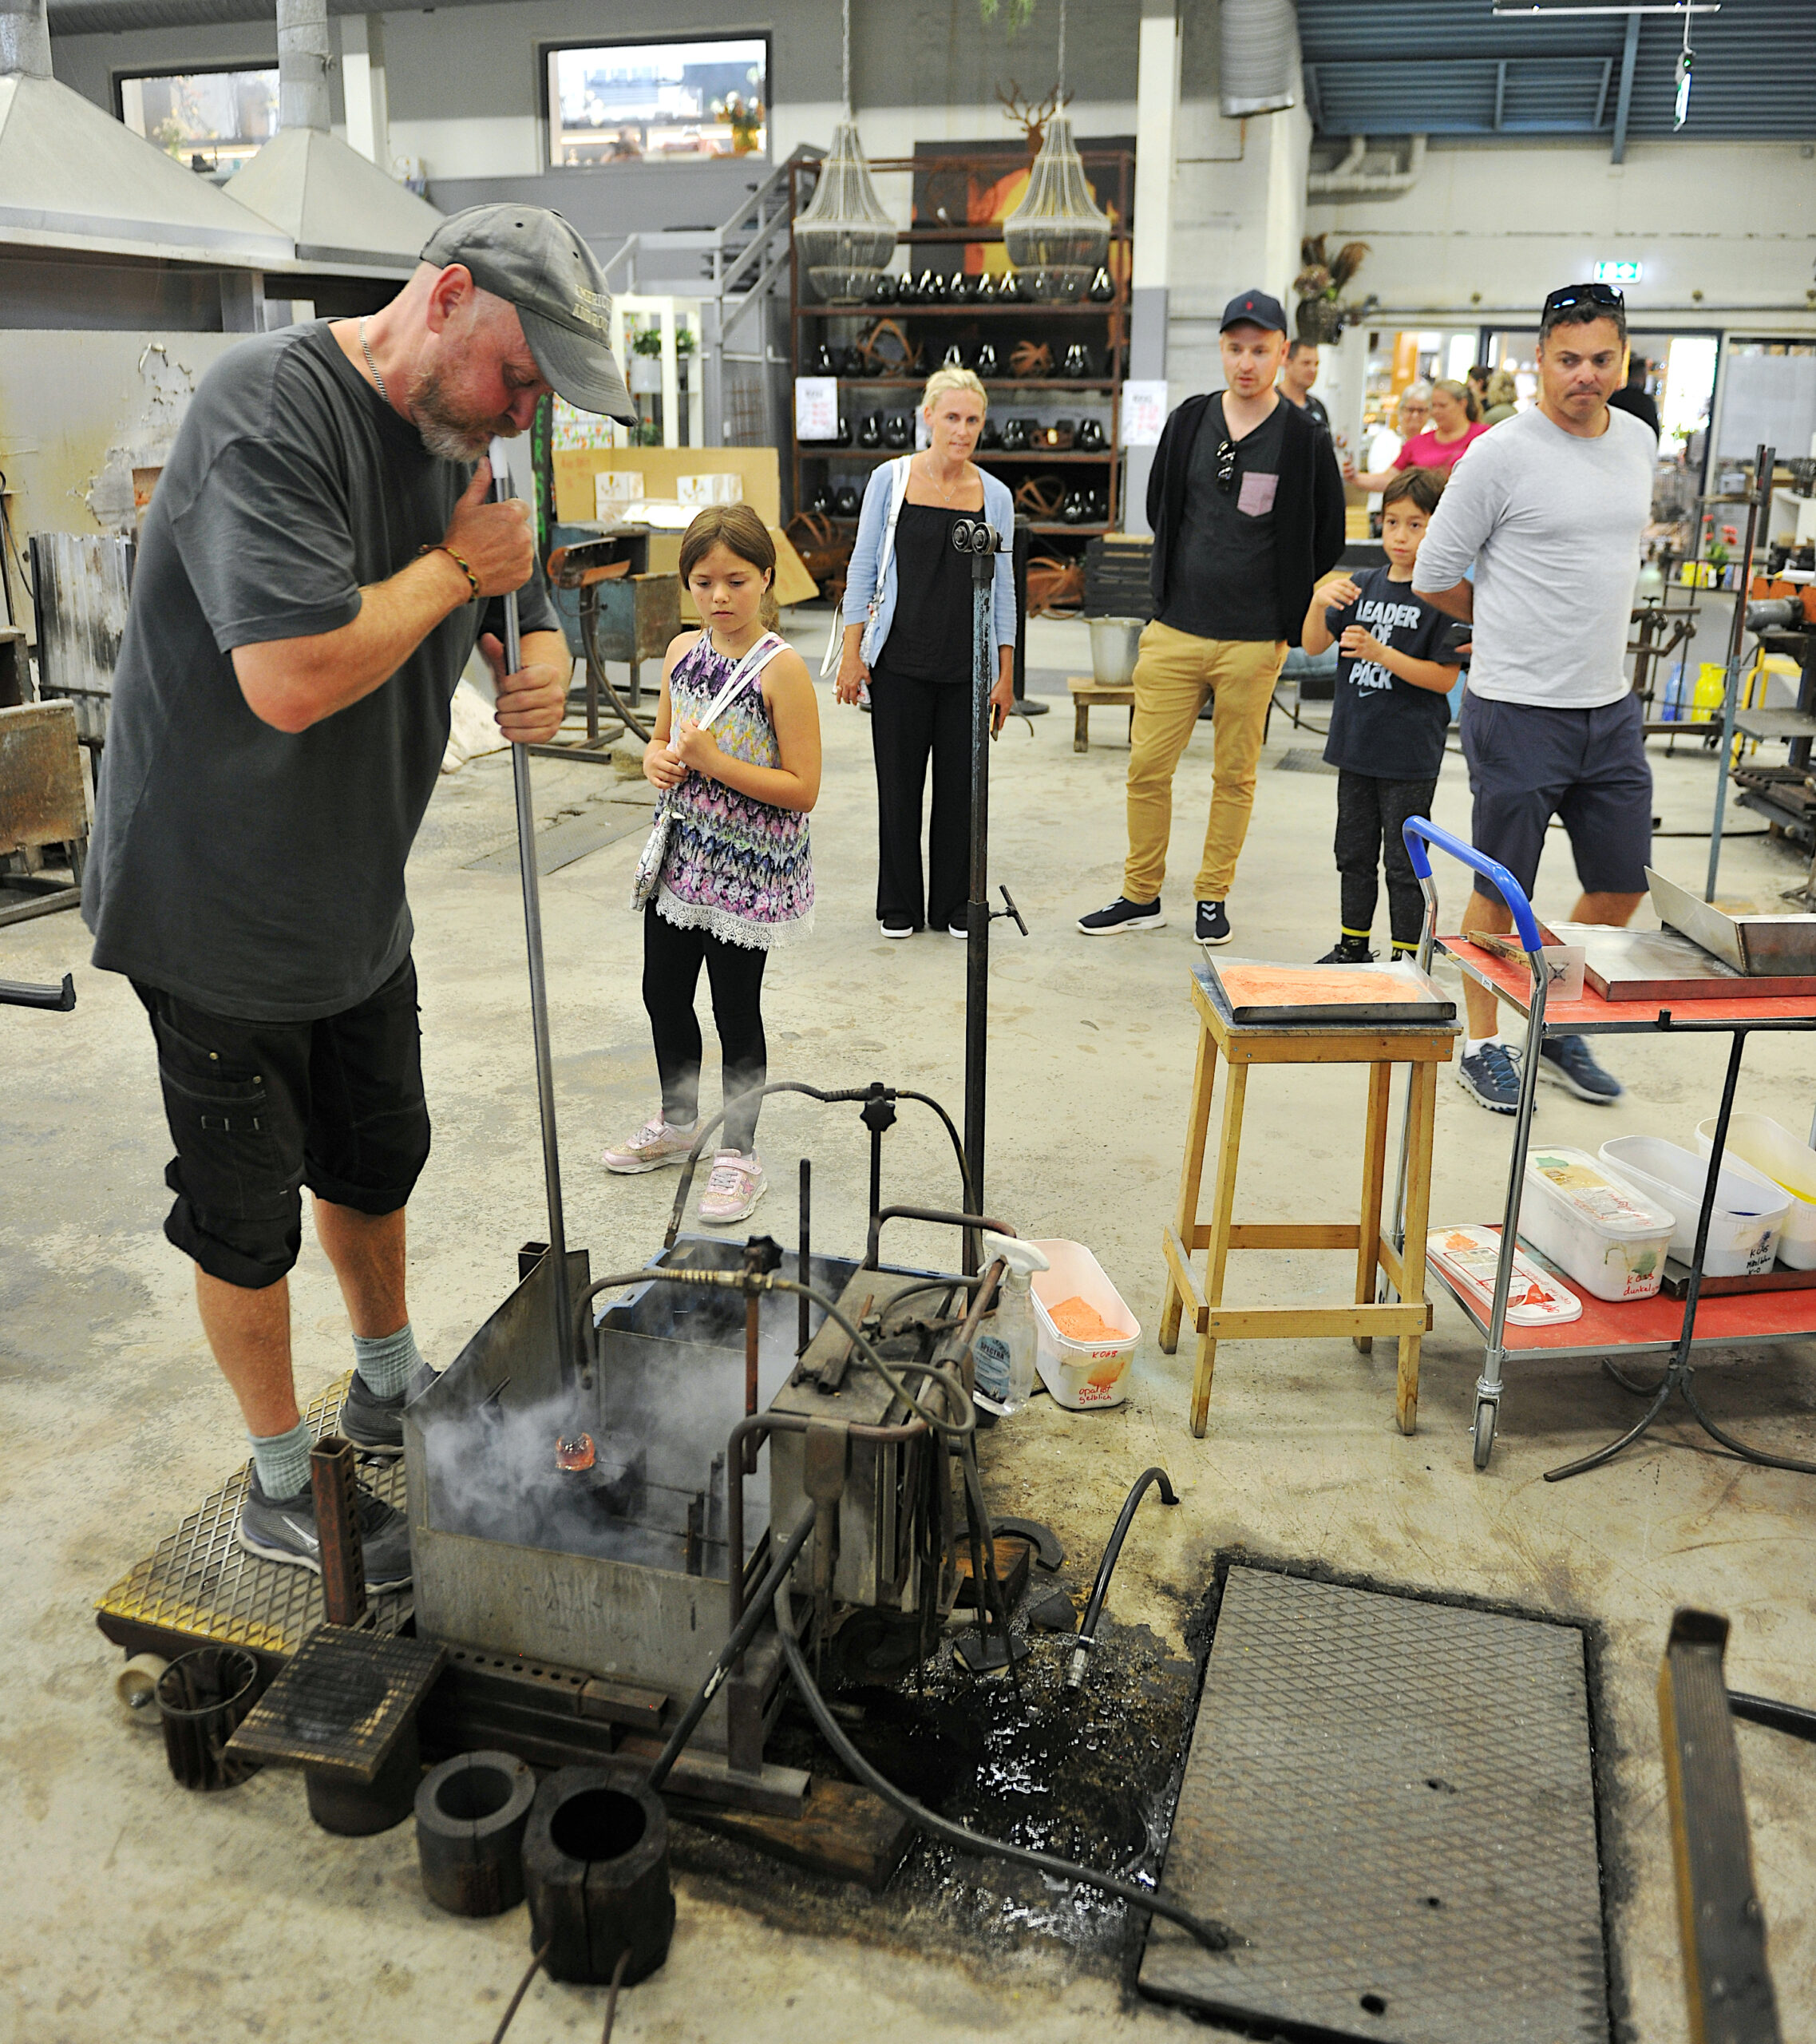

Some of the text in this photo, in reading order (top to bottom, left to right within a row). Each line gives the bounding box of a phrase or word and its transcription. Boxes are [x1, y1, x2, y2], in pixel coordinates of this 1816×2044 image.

[1355, 599, 1421, 630] LEADER
[1371, 624, 1394, 645] OF
[1349, 662, 1392, 691] PACK
[980, 1341, 1005, 1361] SPECTRA
